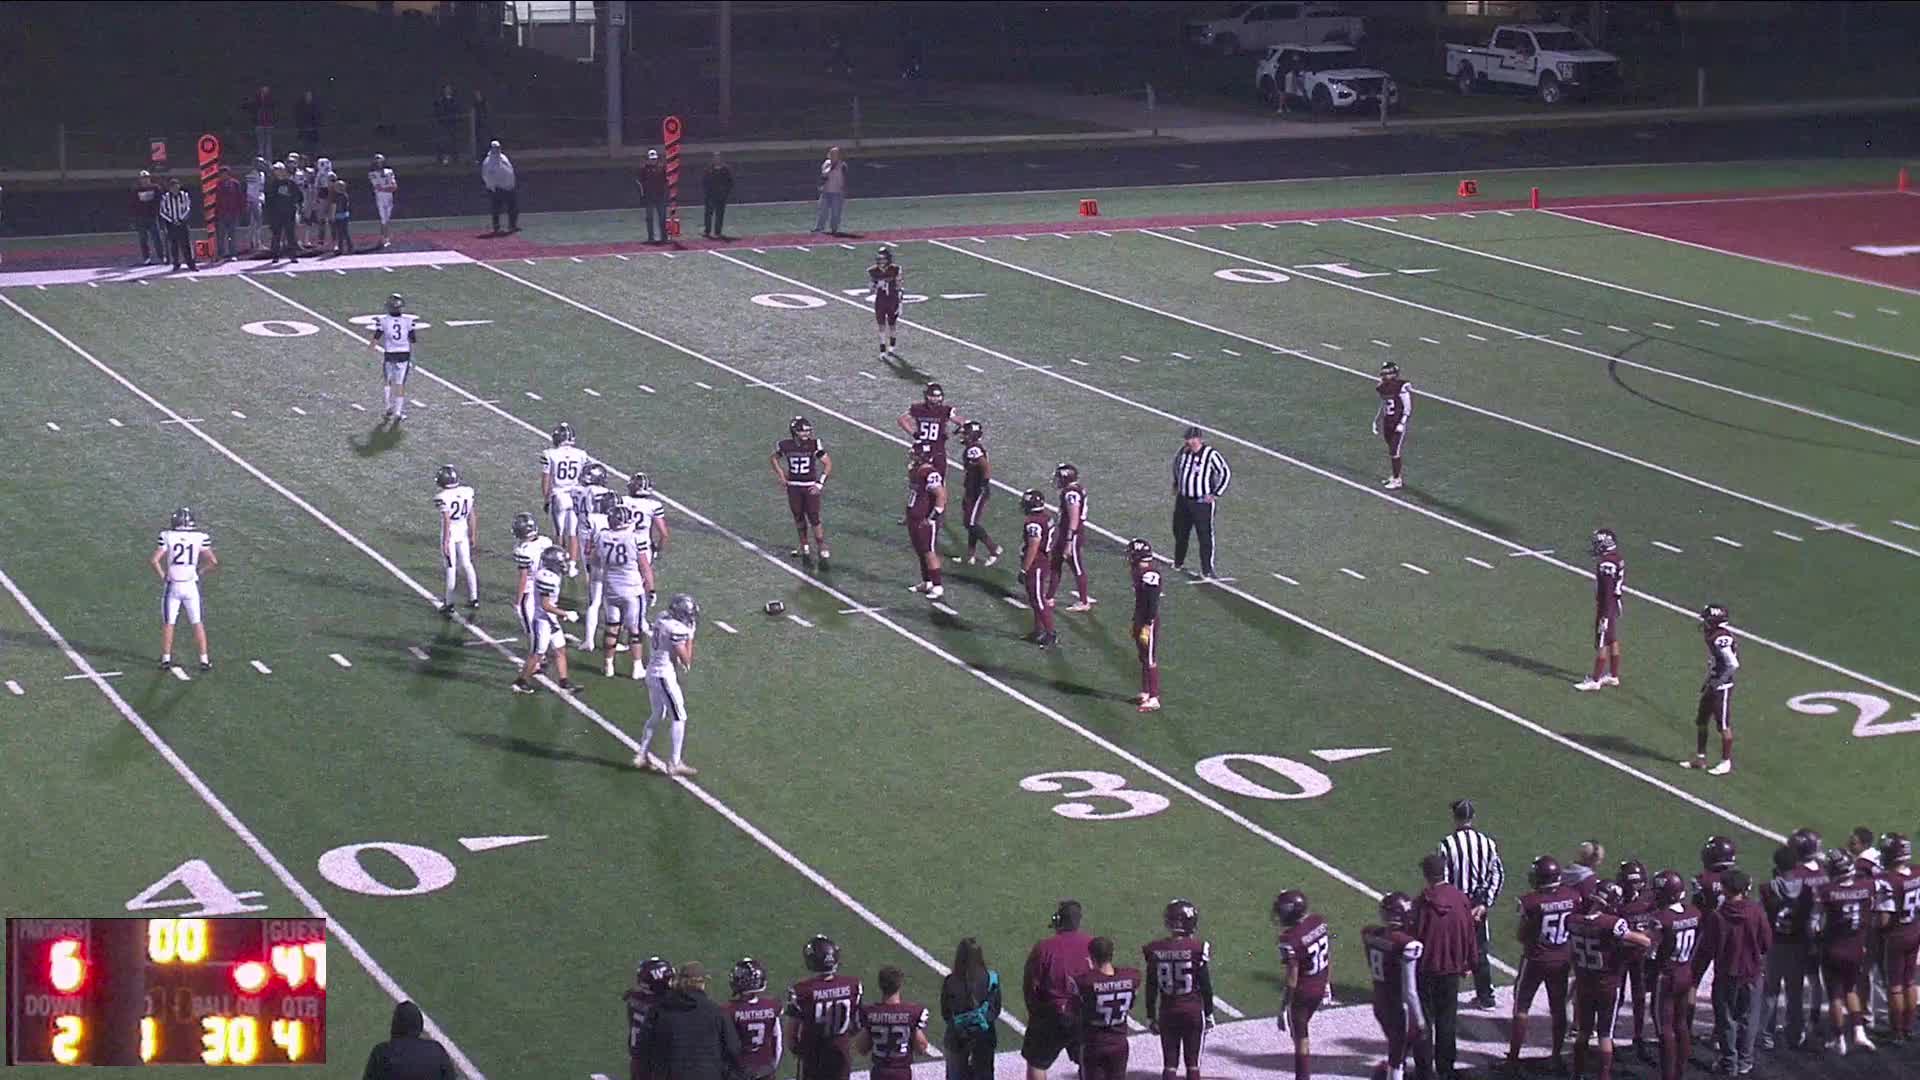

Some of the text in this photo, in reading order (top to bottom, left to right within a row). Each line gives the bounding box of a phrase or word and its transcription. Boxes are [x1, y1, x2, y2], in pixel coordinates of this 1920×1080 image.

[391, 323, 402, 341] 3
[919, 422, 940, 441] 58
[557, 460, 578, 480] 65
[789, 457, 810, 474] 52
[449, 499, 469, 520] 24
[172, 542, 194, 565] 21
[603, 542, 628, 566] 78
[1541, 900, 1574, 912] PANTHERS
[1307, 935, 1329, 976] 32
[1670, 929, 1696, 963] 10
[650, 966, 668, 980] W
[1156, 961, 1193, 996] 85
[813, 985, 851, 1000] PANTHERS
[1093, 979, 1133, 993] PANTHERS
[735, 1008, 776, 1022] PANTHERS
[815, 1000, 851, 1039] 40
[747, 1023, 766, 1051] 3
